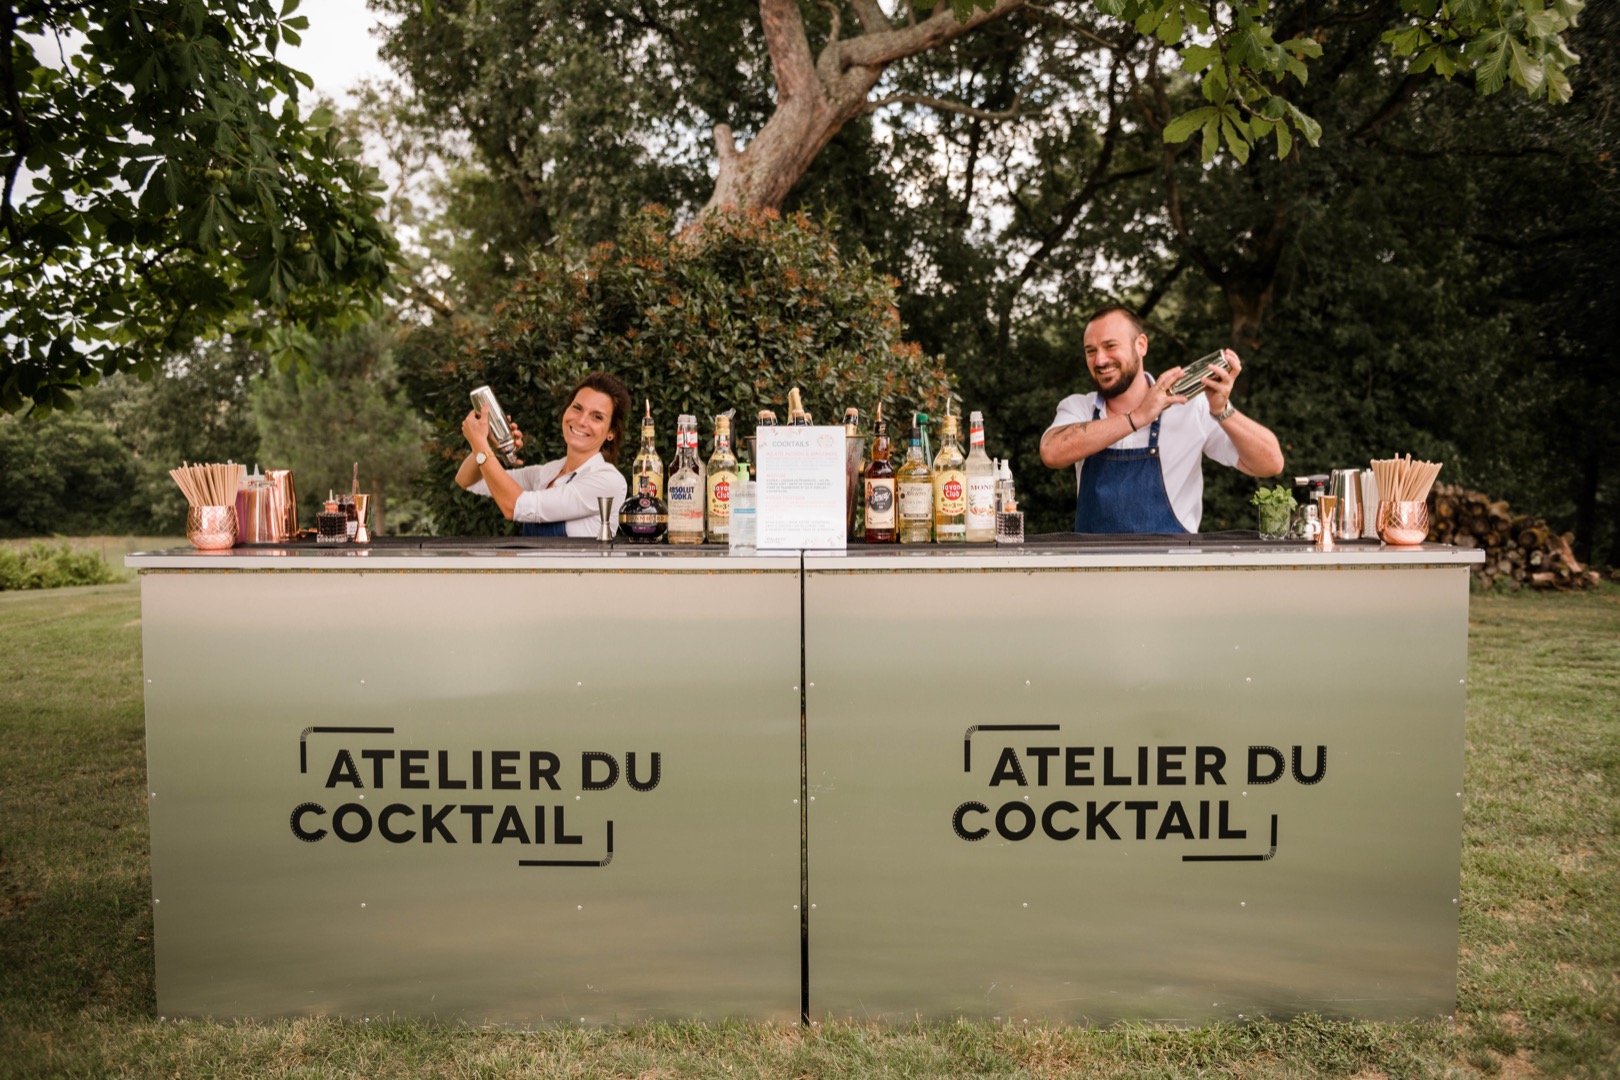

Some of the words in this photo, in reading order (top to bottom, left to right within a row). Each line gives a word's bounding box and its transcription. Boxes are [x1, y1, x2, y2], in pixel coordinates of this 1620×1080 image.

[325, 749, 562, 790] ATELIER
[581, 751, 662, 792] DU
[988, 746, 1227, 787] ATELIER
[1247, 745, 1328, 785] DU
[290, 802, 583, 845] COCKTAIL
[952, 800, 1247, 842] COCKTAIL
